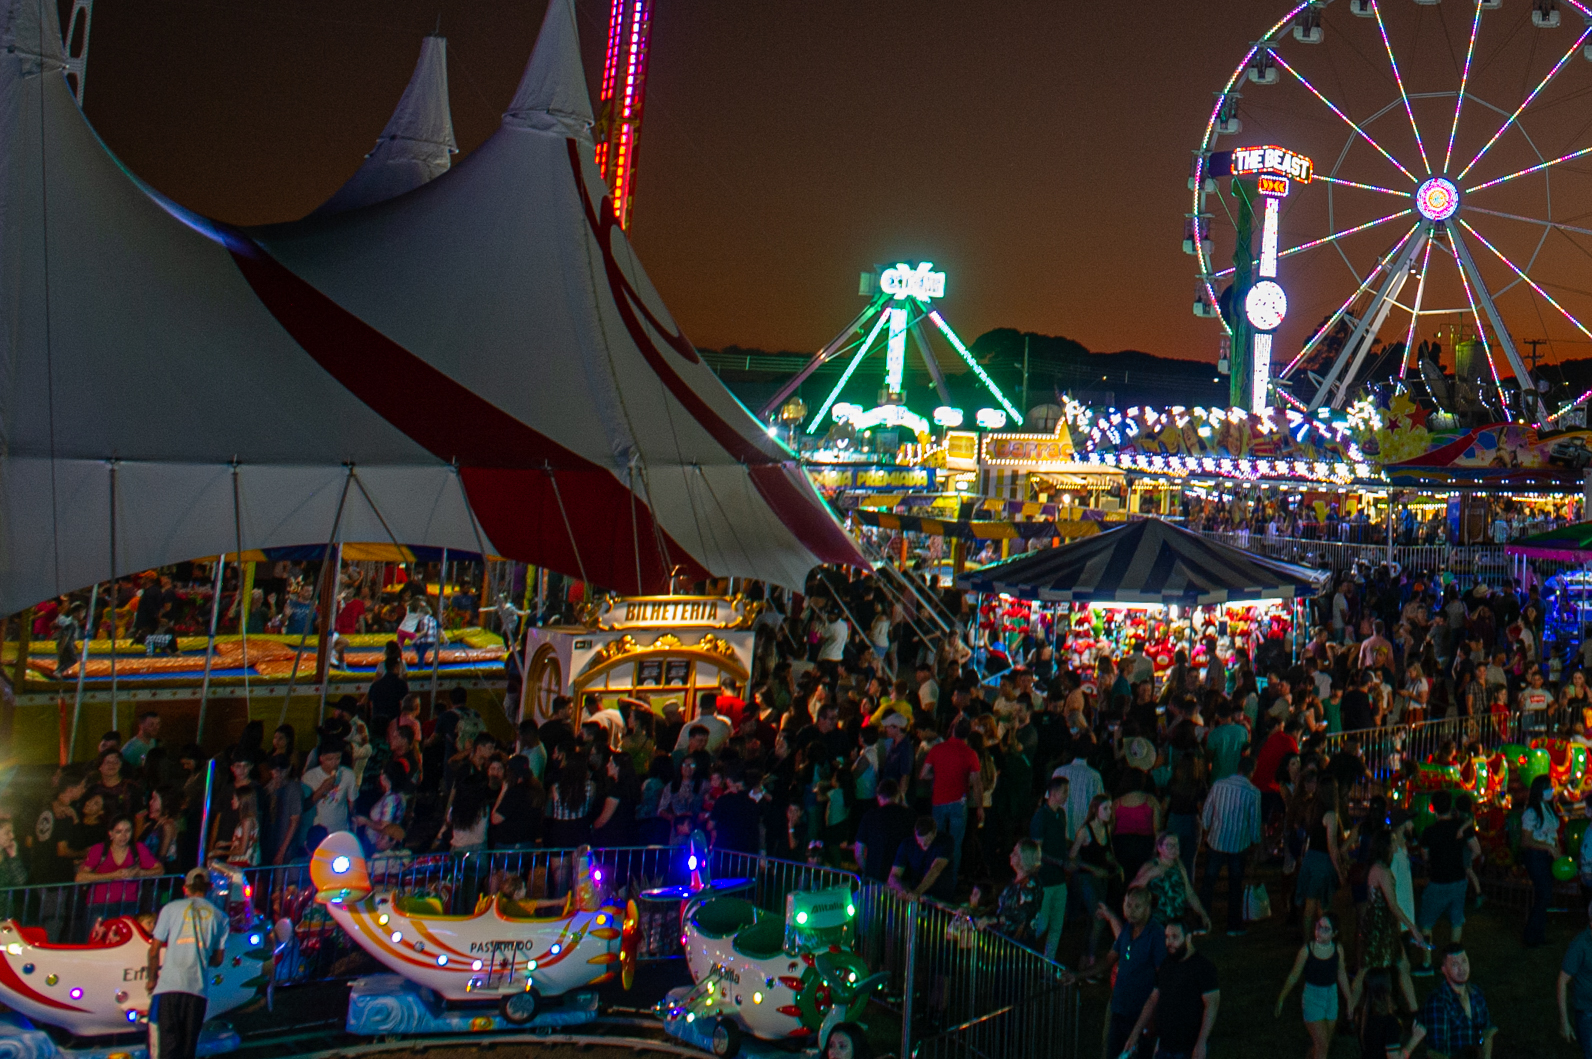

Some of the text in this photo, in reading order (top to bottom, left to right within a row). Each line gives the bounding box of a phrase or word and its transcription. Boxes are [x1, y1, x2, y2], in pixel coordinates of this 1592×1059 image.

[1236, 149, 1310, 179] THE BEAST
[856, 469, 929, 487] PREMIADA
[625, 601, 719, 622] BILHETERIA
